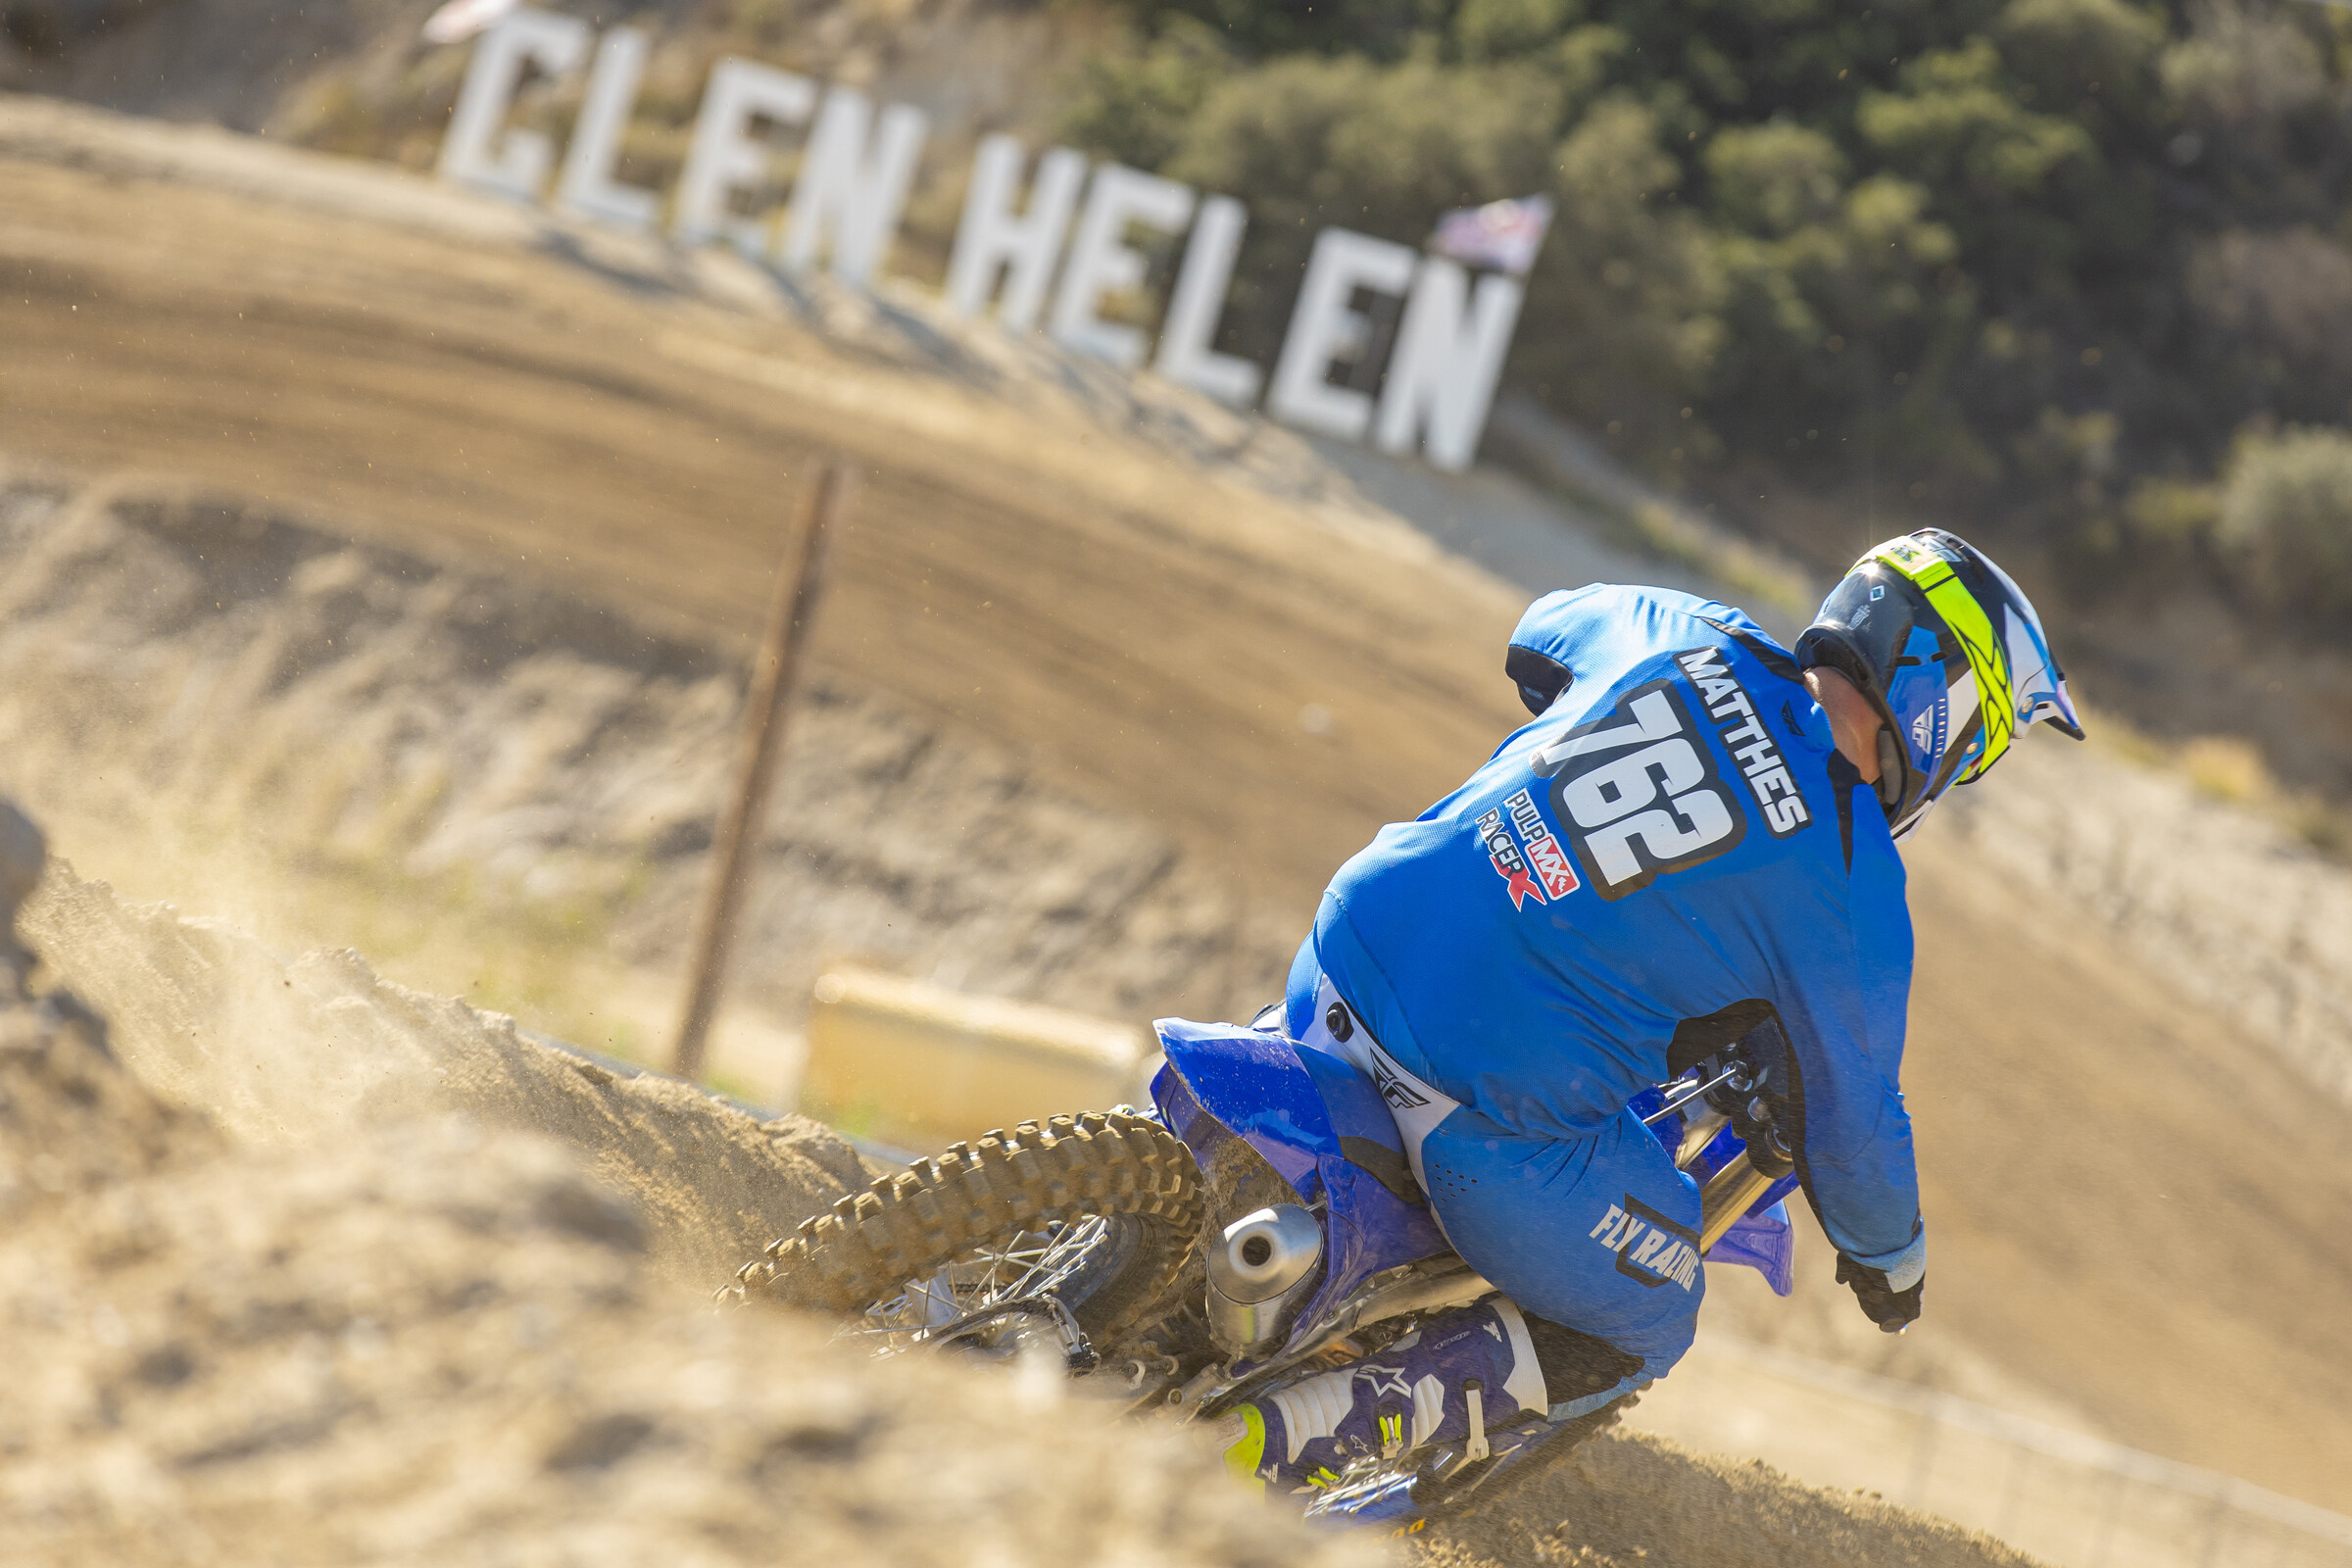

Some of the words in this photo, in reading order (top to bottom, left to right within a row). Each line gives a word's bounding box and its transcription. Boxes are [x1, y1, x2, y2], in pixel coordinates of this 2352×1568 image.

[437, 7, 929, 288] GLEN
[945, 132, 1525, 470] HELEN
[1544, 689, 1735, 887] 762
[1678, 646, 1809, 834] MATTHES
[1476, 808, 1526, 879] RACER
[1588, 1202, 1647, 1253] FLY
[1629, 1228, 1700, 1293] RACING
